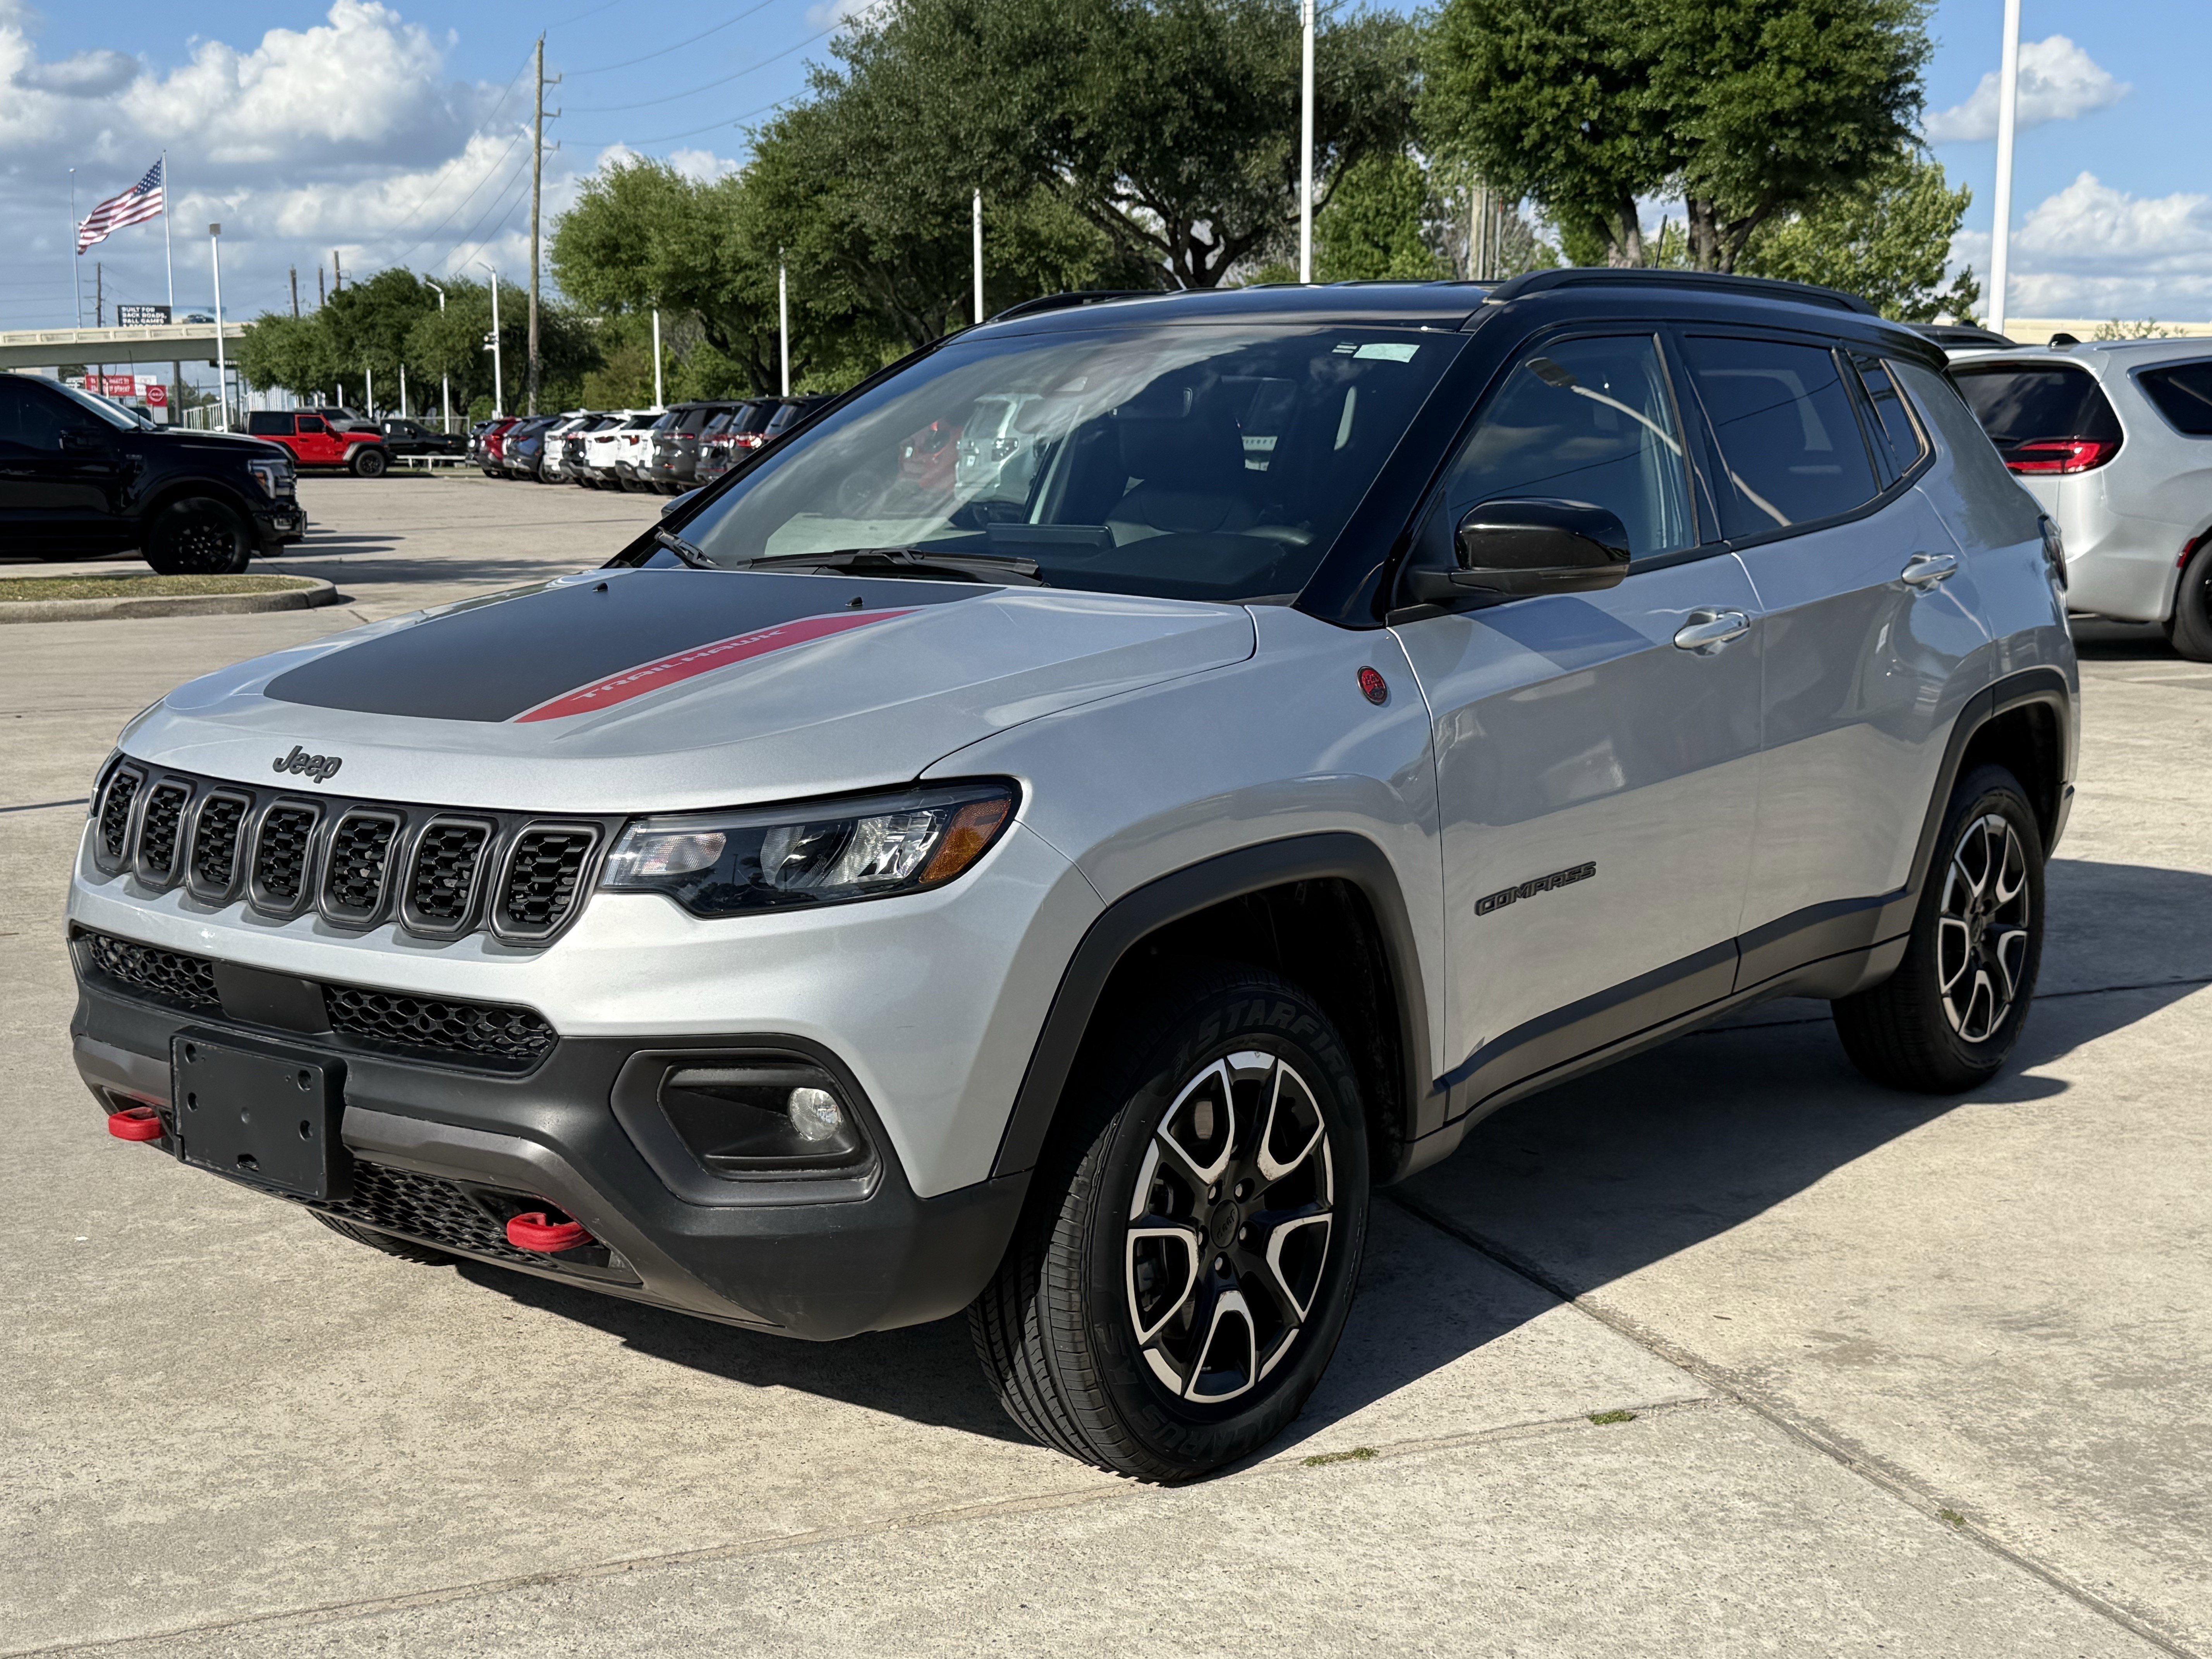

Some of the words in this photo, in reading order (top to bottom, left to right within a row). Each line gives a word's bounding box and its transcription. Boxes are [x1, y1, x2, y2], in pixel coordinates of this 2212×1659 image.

[569, 630, 787, 701] TRAILHAWK
[273, 745, 342, 784] Jeep
[1474, 861, 1597, 916] COMPASS
[1193, 999, 1358, 1106] STARFIRE
[1217, 1208, 1236, 1240] Jeep
